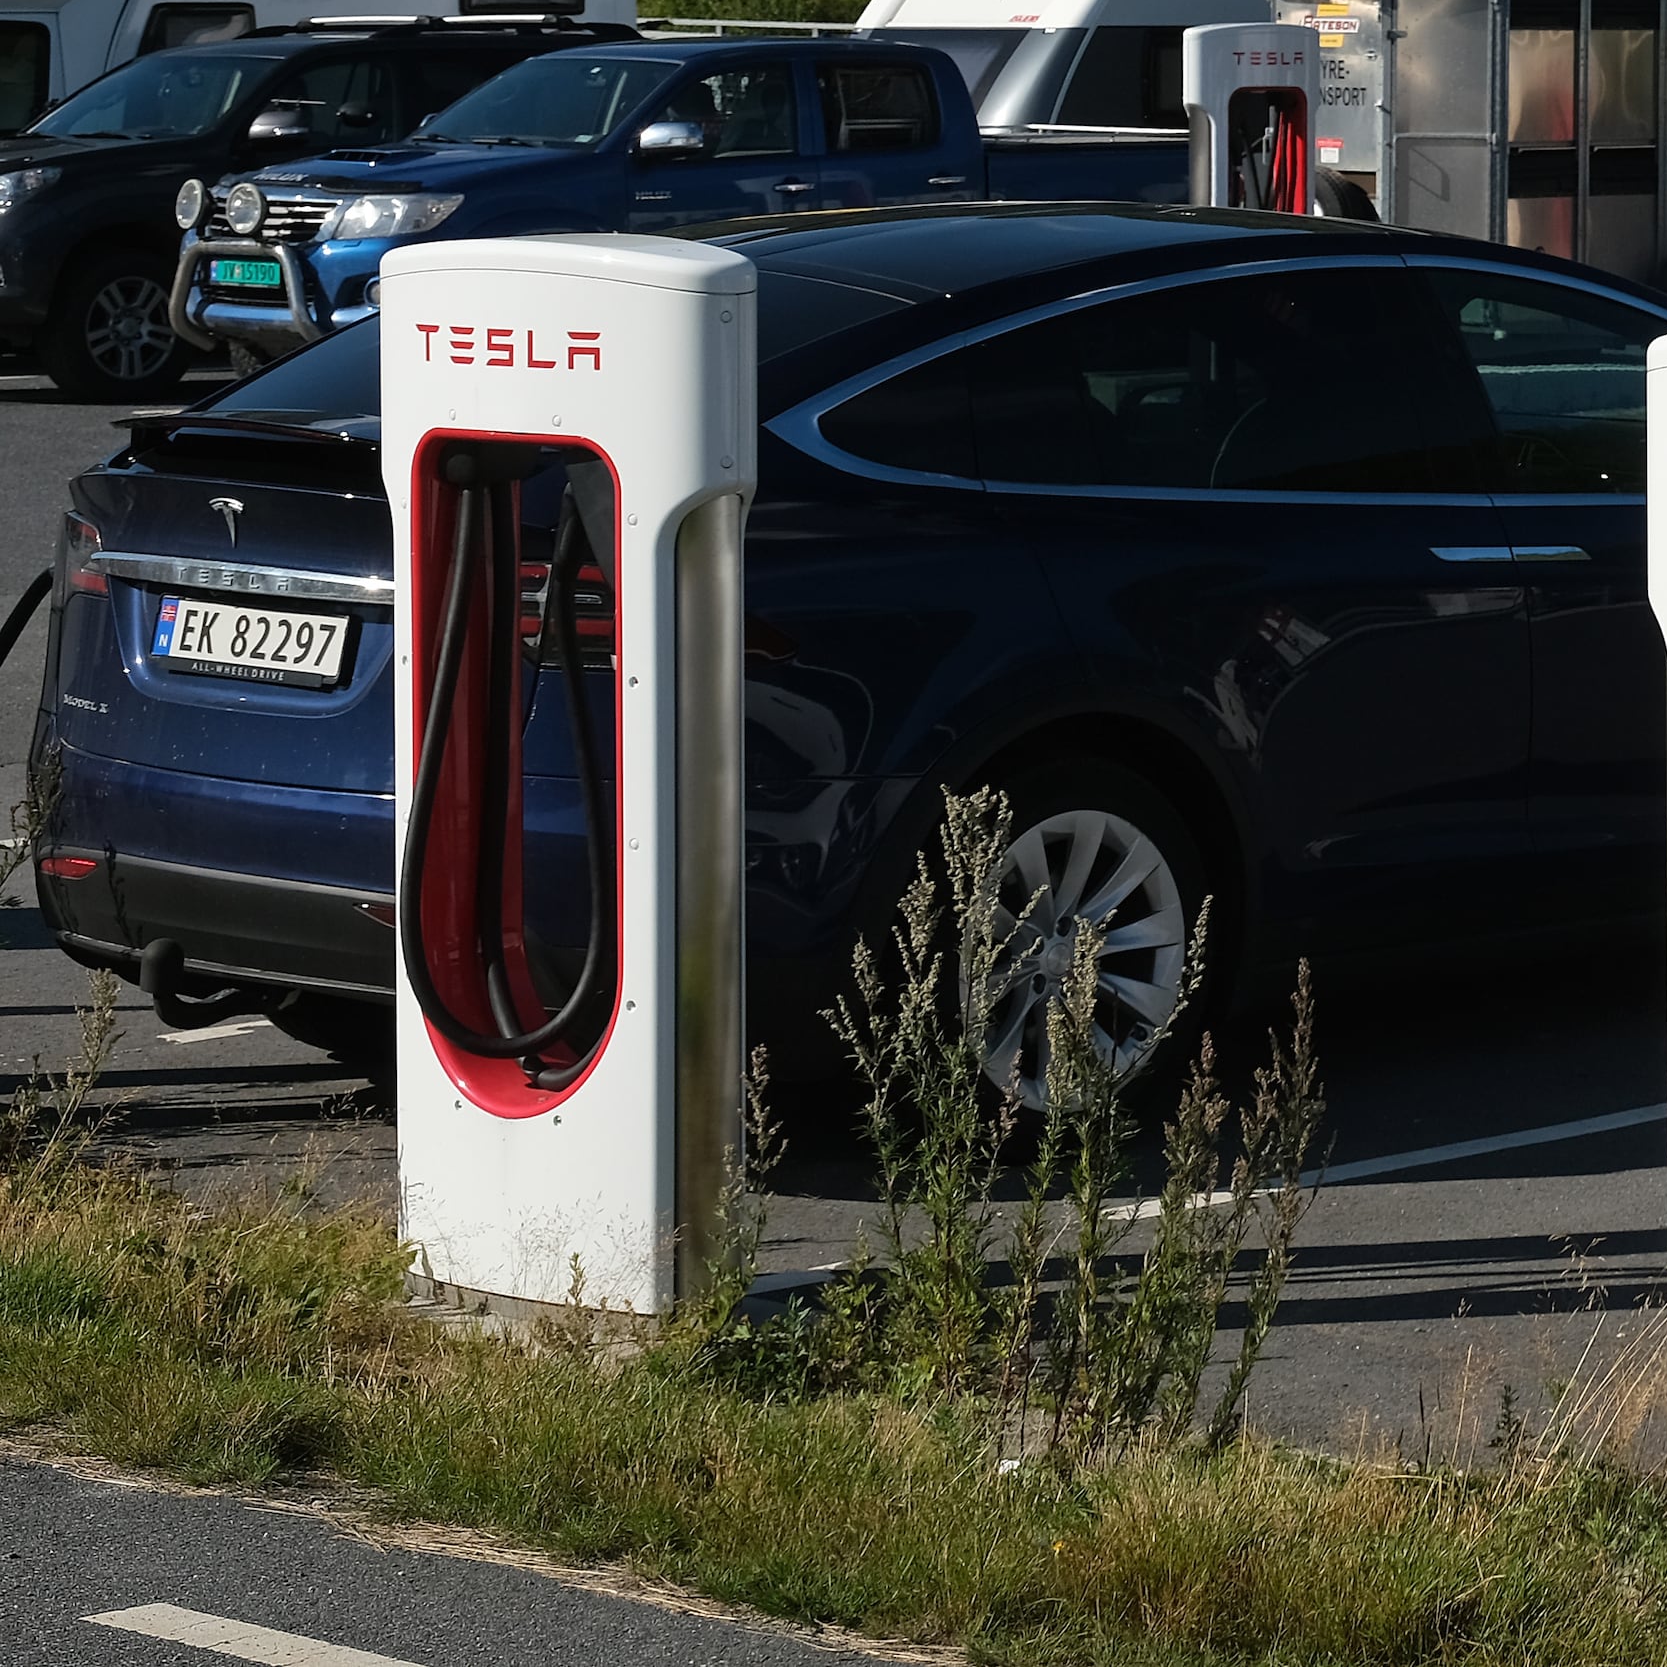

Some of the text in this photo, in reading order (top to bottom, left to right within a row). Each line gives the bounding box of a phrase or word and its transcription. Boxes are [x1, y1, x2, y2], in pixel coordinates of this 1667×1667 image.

[1232, 51, 1303, 66] TESLA
[1321, 60, 1350, 80] YRE-
[1320, 87, 1367, 107] NSPORT
[240, 263, 276, 282] 15190
[416, 323, 601, 371] TESLA
[176, 566, 290, 592] TESLA
[179, 609, 338, 667] EK 82297
